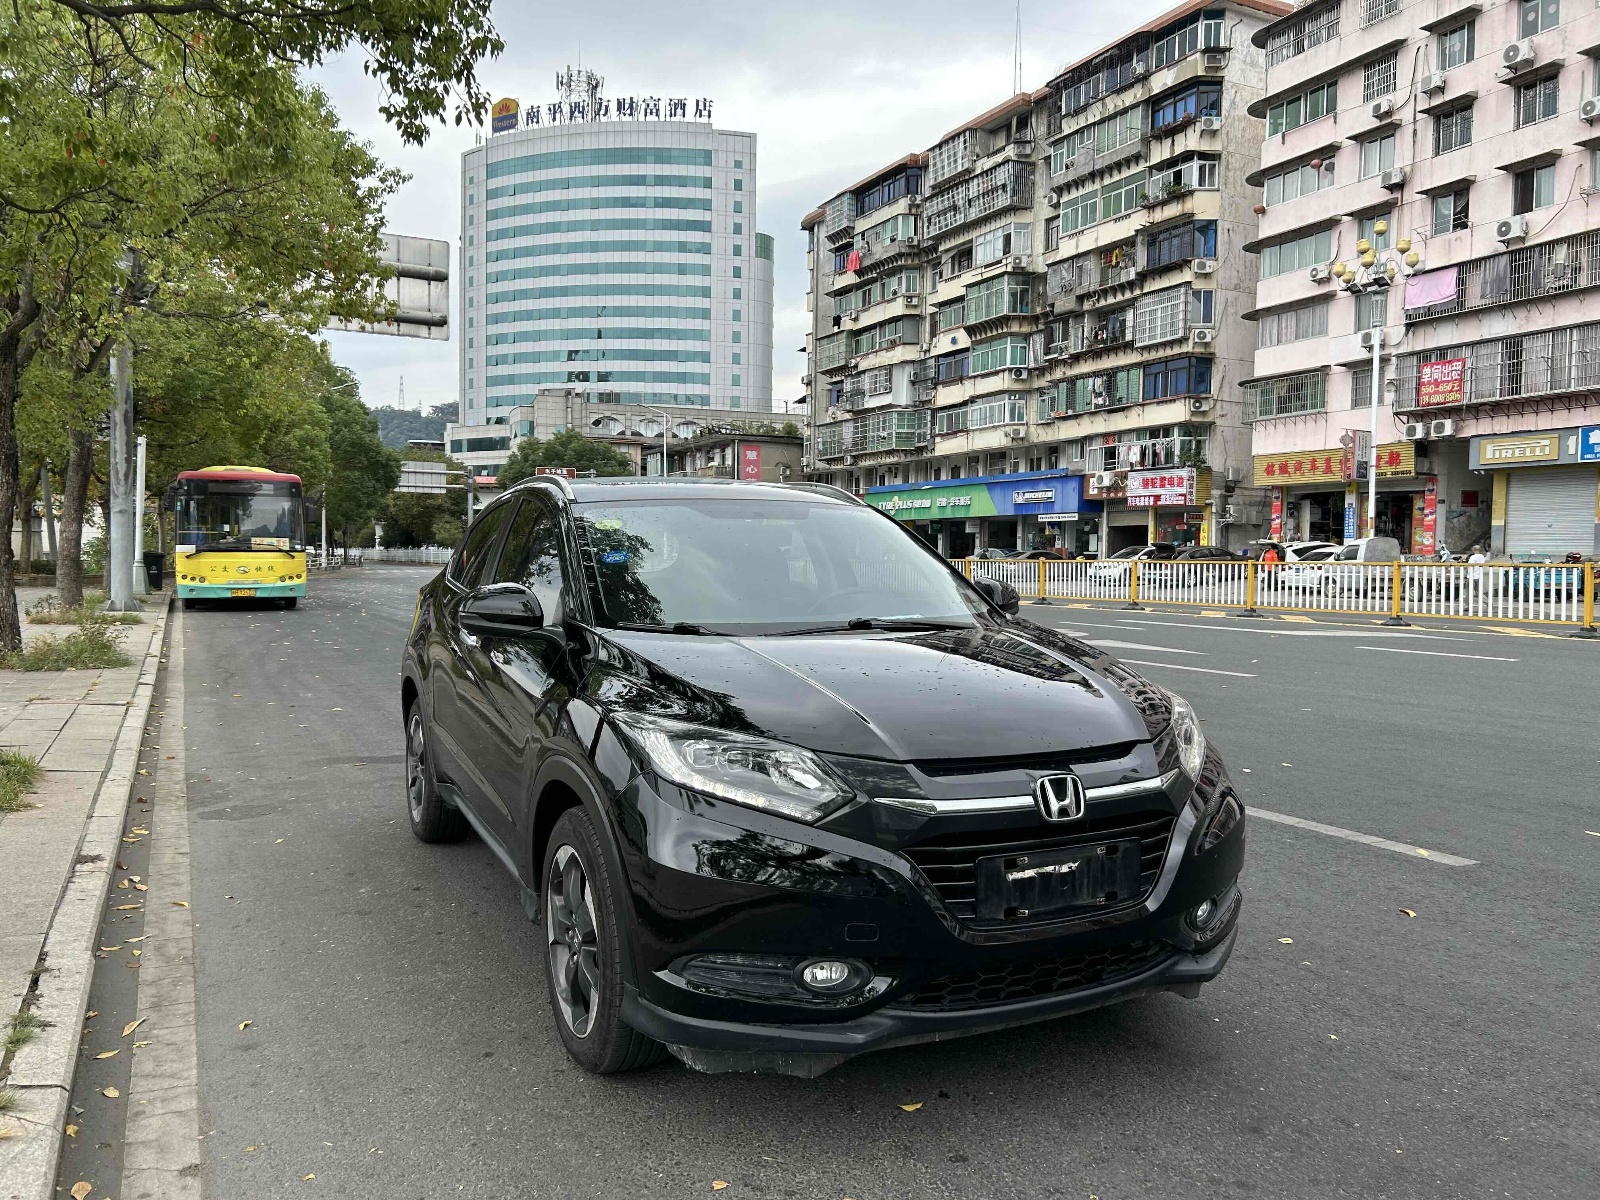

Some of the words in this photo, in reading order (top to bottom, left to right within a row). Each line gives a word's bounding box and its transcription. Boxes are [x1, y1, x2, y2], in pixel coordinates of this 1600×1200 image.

[525, 96, 713, 126] 南平西方财富酒店
[1421, 362, 1462, 383] 单间出租
[1486, 440, 1551, 459] PIRELLI
[745, 450, 758, 480] 慧心
[1142, 475, 1185, 489] 骆驼蓄电池
